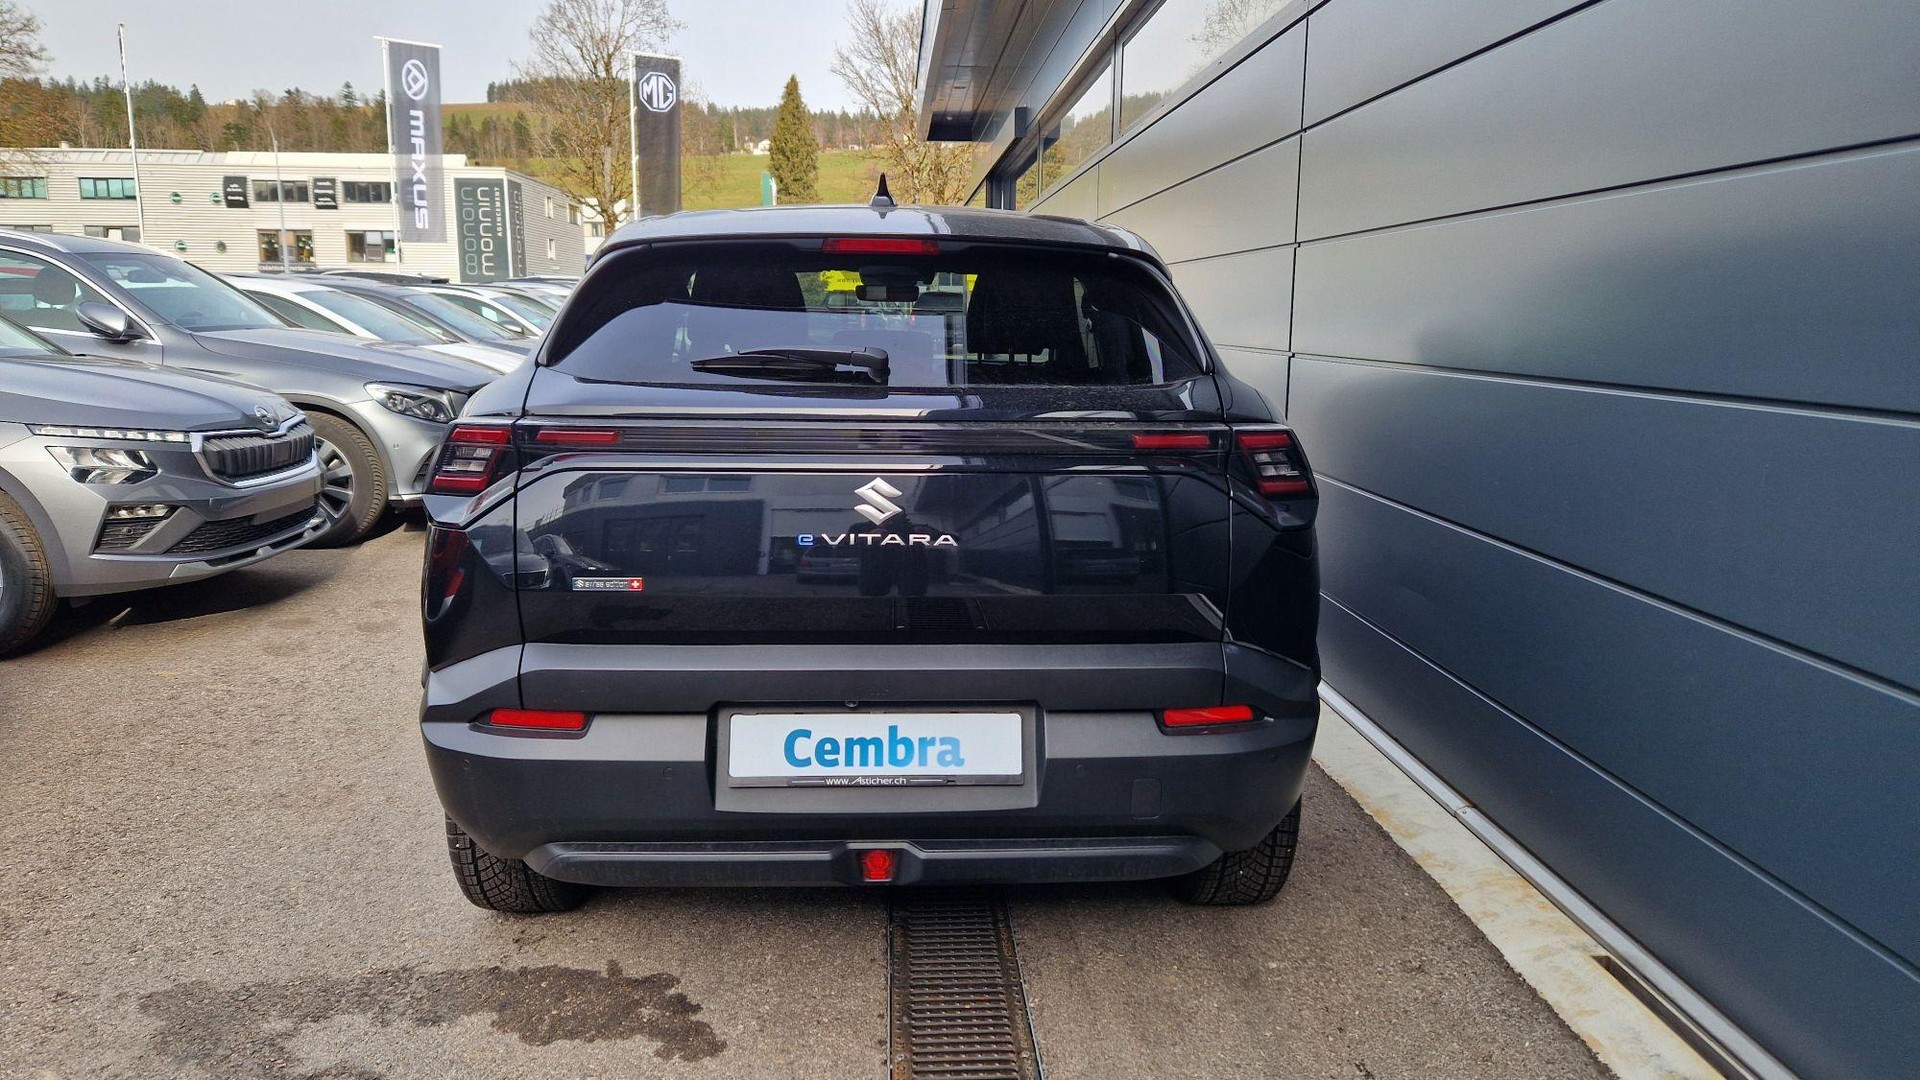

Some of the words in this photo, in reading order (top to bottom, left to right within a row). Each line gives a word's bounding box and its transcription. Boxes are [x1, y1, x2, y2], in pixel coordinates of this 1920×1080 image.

[641, 74, 674, 110] MG
[409, 109, 429, 230] MAXUS
[477, 186, 495, 276] monnin
[494, 186, 503, 237] AGENCEMENT
[821, 533, 959, 547] VITARA
[783, 725, 965, 768] Cembra
[825, 776, 907, 785] www.Asticher.ch
